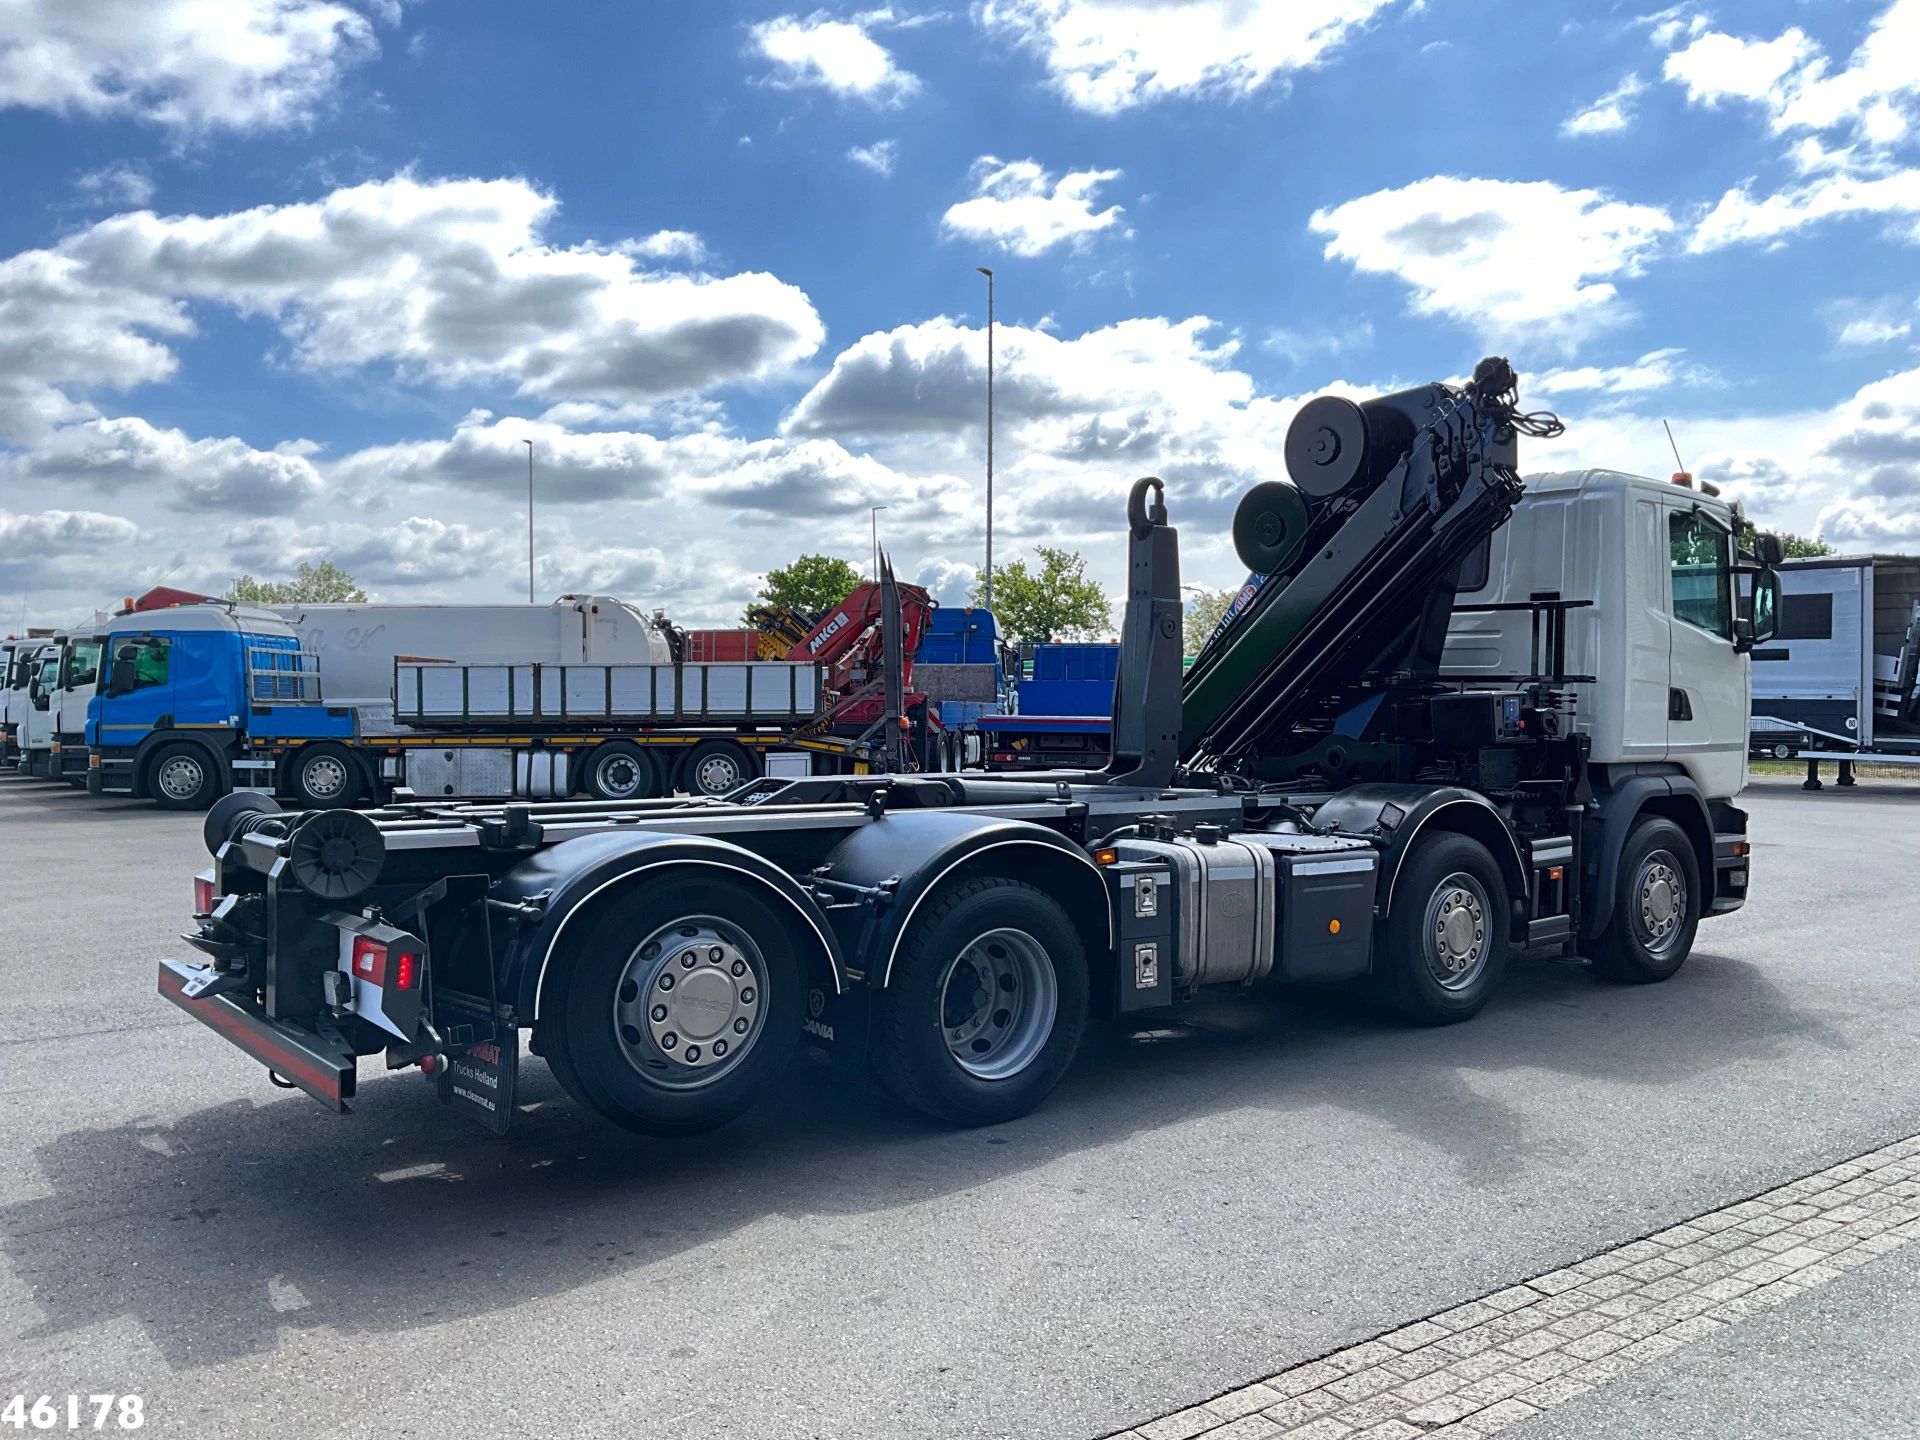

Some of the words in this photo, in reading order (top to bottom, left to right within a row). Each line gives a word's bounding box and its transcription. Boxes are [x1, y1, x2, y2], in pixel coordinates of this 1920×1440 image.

[810, 621, 840, 655] MKG
[453, 1060, 473, 1078] Trucks
[474, 1068, 498, 1089] Holland
[453, 1085, 495, 1111] www.cleanmat.eu
